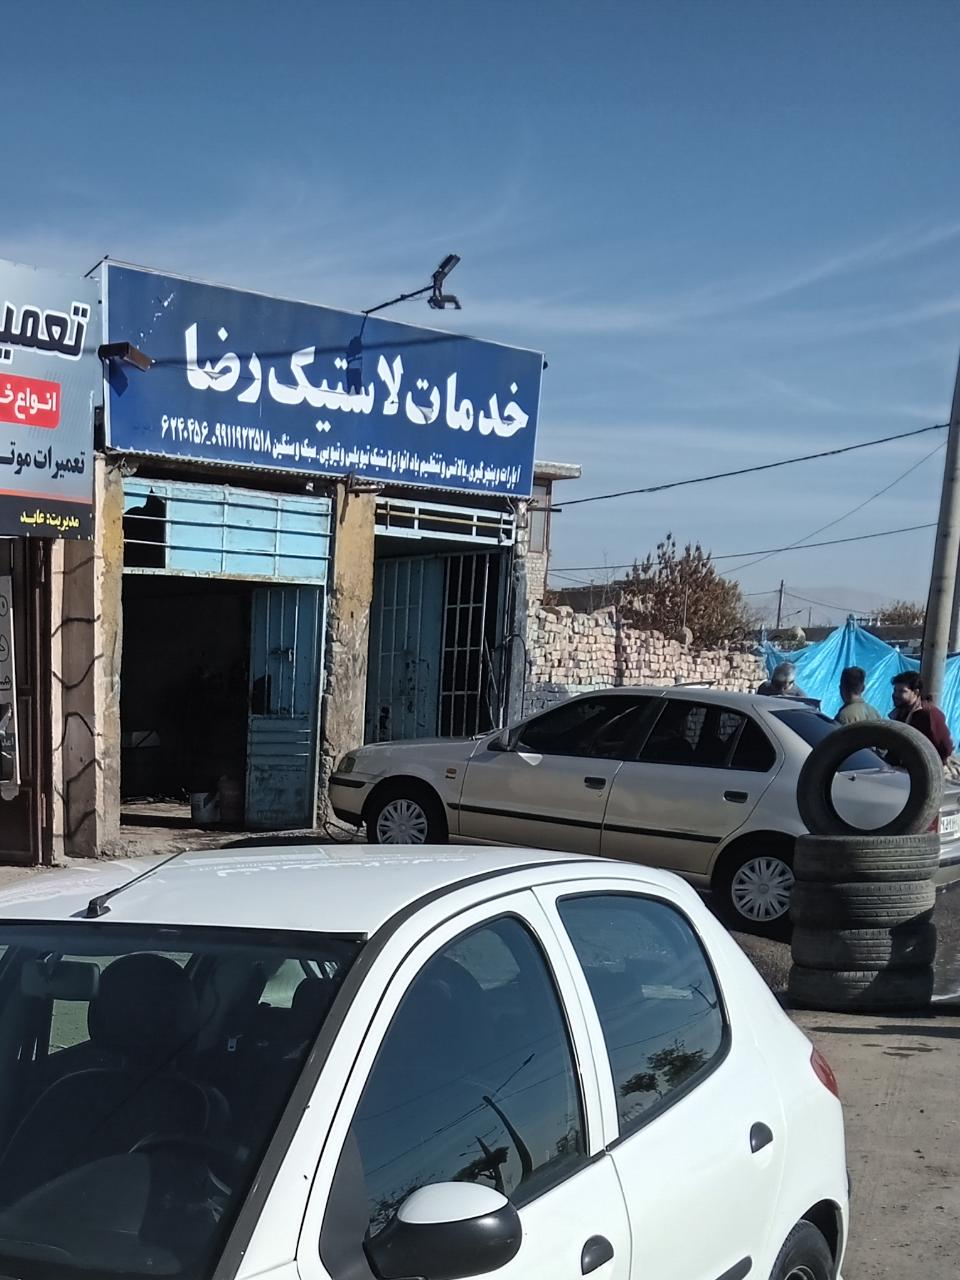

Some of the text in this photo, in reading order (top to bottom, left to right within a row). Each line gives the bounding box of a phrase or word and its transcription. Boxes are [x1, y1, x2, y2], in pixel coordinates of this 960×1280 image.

[184, 322, 529, 437] خدمات لاستیک رضا
[14, 388, 57, 419] انواع
[33, 445, 85, 479] تعمیرات
[20, 509, 45, 526] عابد
